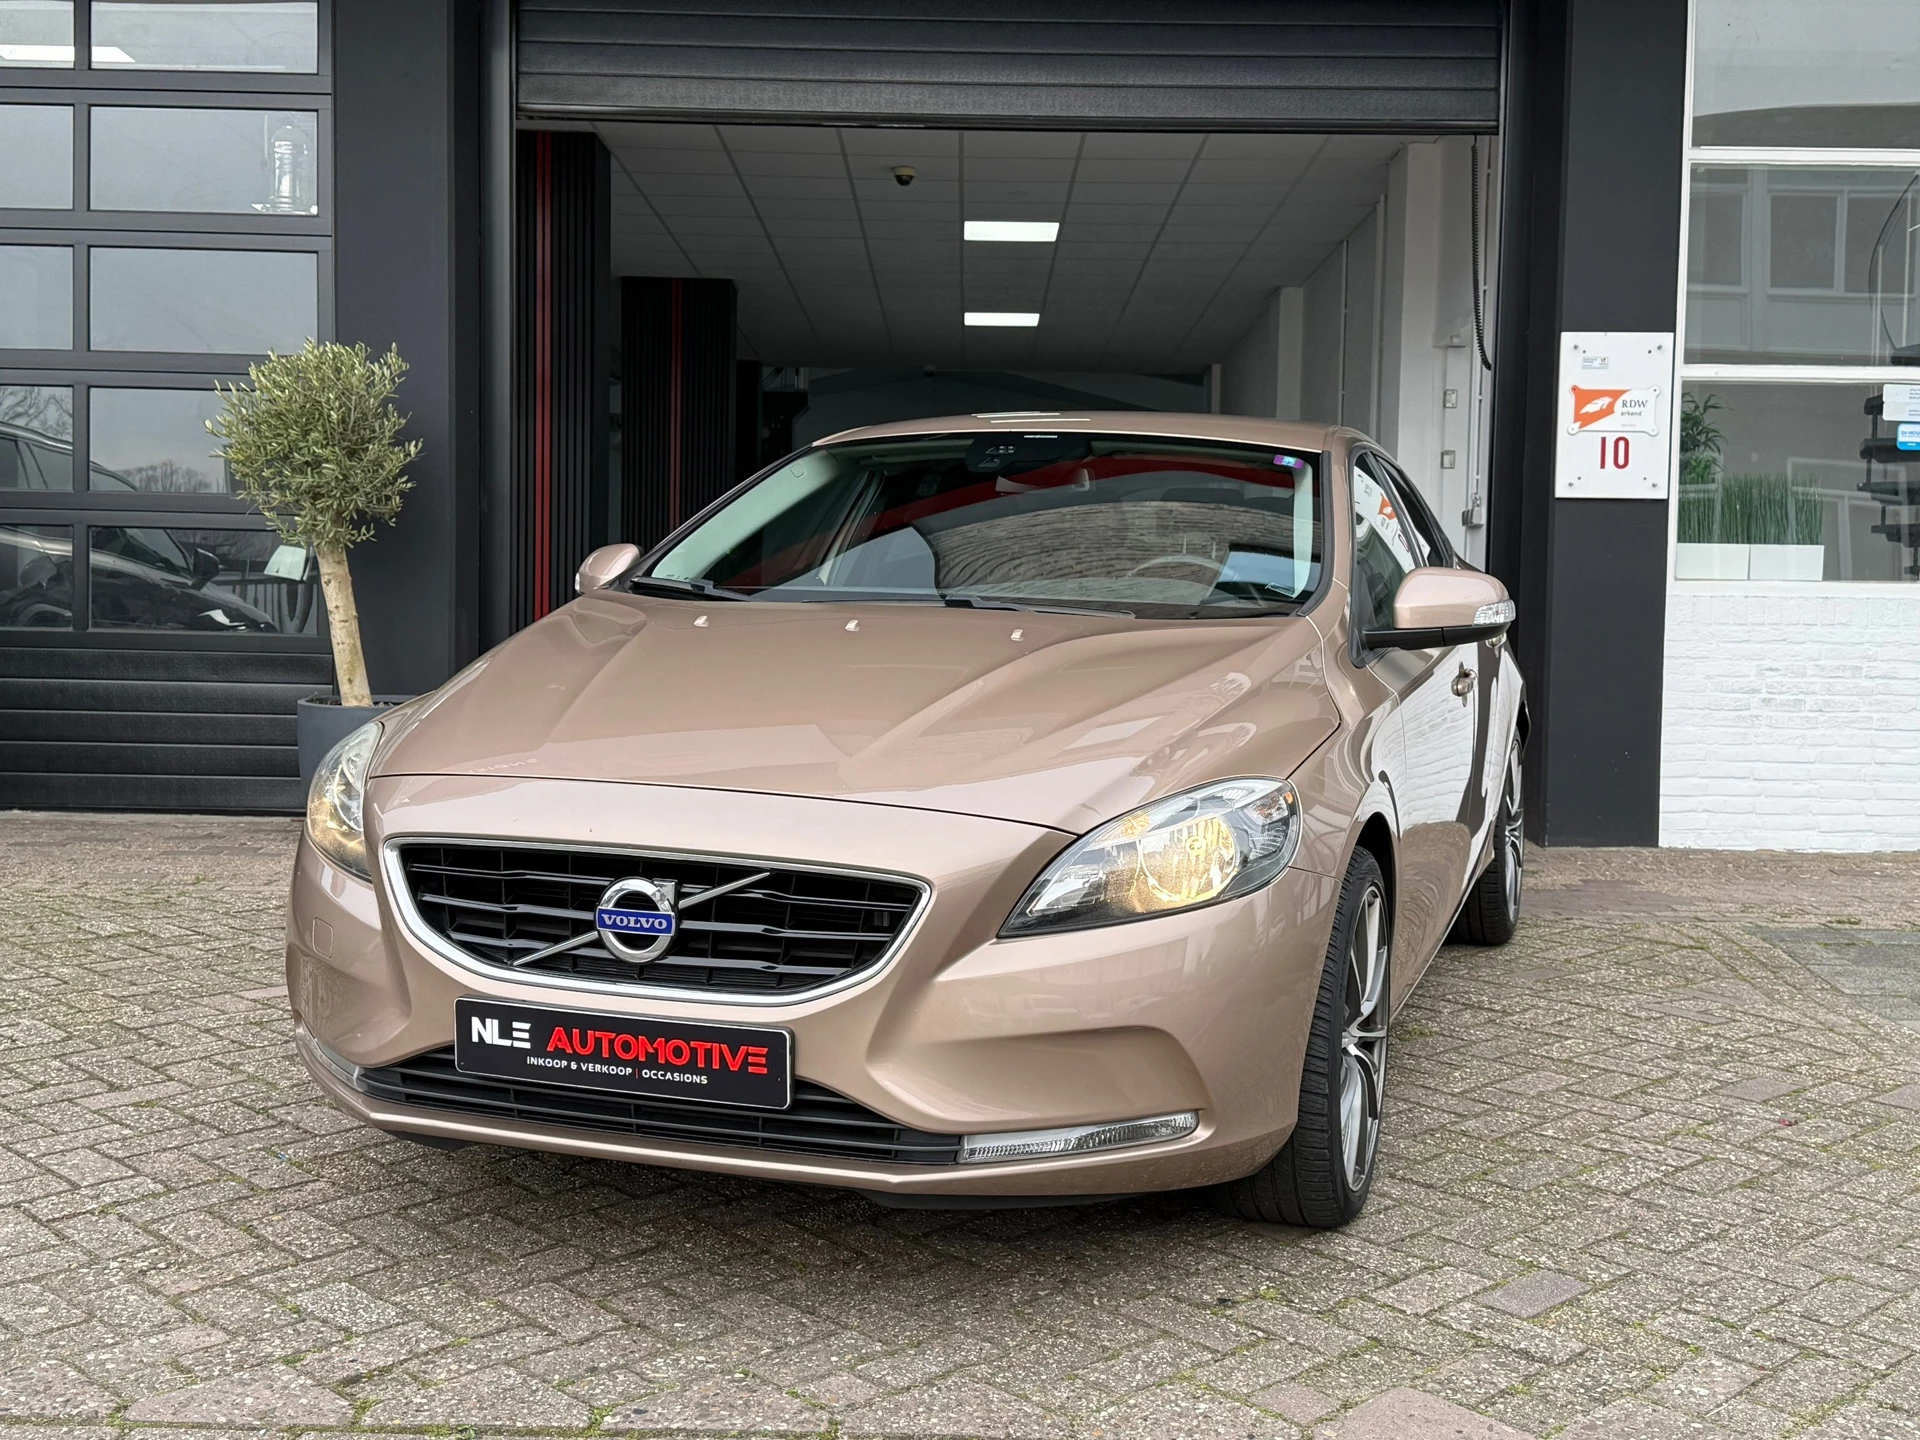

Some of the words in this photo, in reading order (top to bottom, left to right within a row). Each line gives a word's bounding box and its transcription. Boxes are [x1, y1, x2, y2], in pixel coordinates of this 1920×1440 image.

[1621, 399, 1649, 408] RDW
[1599, 436, 1630, 470] 10
[601, 913, 668, 930] VOLVO
[470, 1016, 532, 1050] NLE
[546, 1026, 769, 1075] AUTOMOTIVE
[526, 1055, 568, 1070] INKOOP
[570, 1061, 578, 1070] &
[580, 1062, 633, 1077] VERKOOP
[641, 1069, 709, 1086] OCCASIONS
